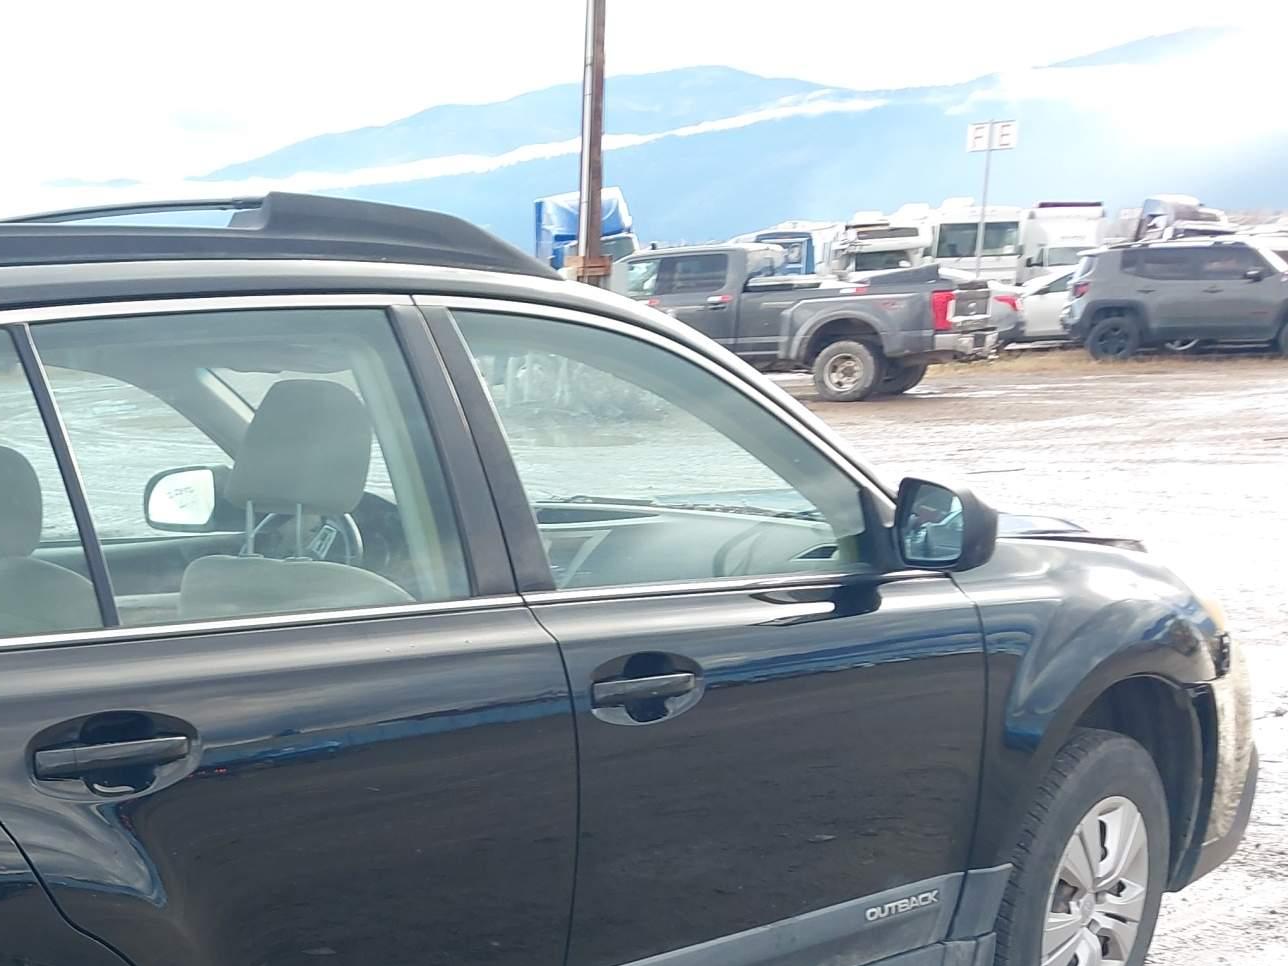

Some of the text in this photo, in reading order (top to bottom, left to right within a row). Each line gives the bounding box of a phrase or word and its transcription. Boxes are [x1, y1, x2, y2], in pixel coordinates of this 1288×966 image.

[972, 126, 984, 148] F
[999, 123, 1012, 147] E
[865, 889, 939, 921] OUTBACK
